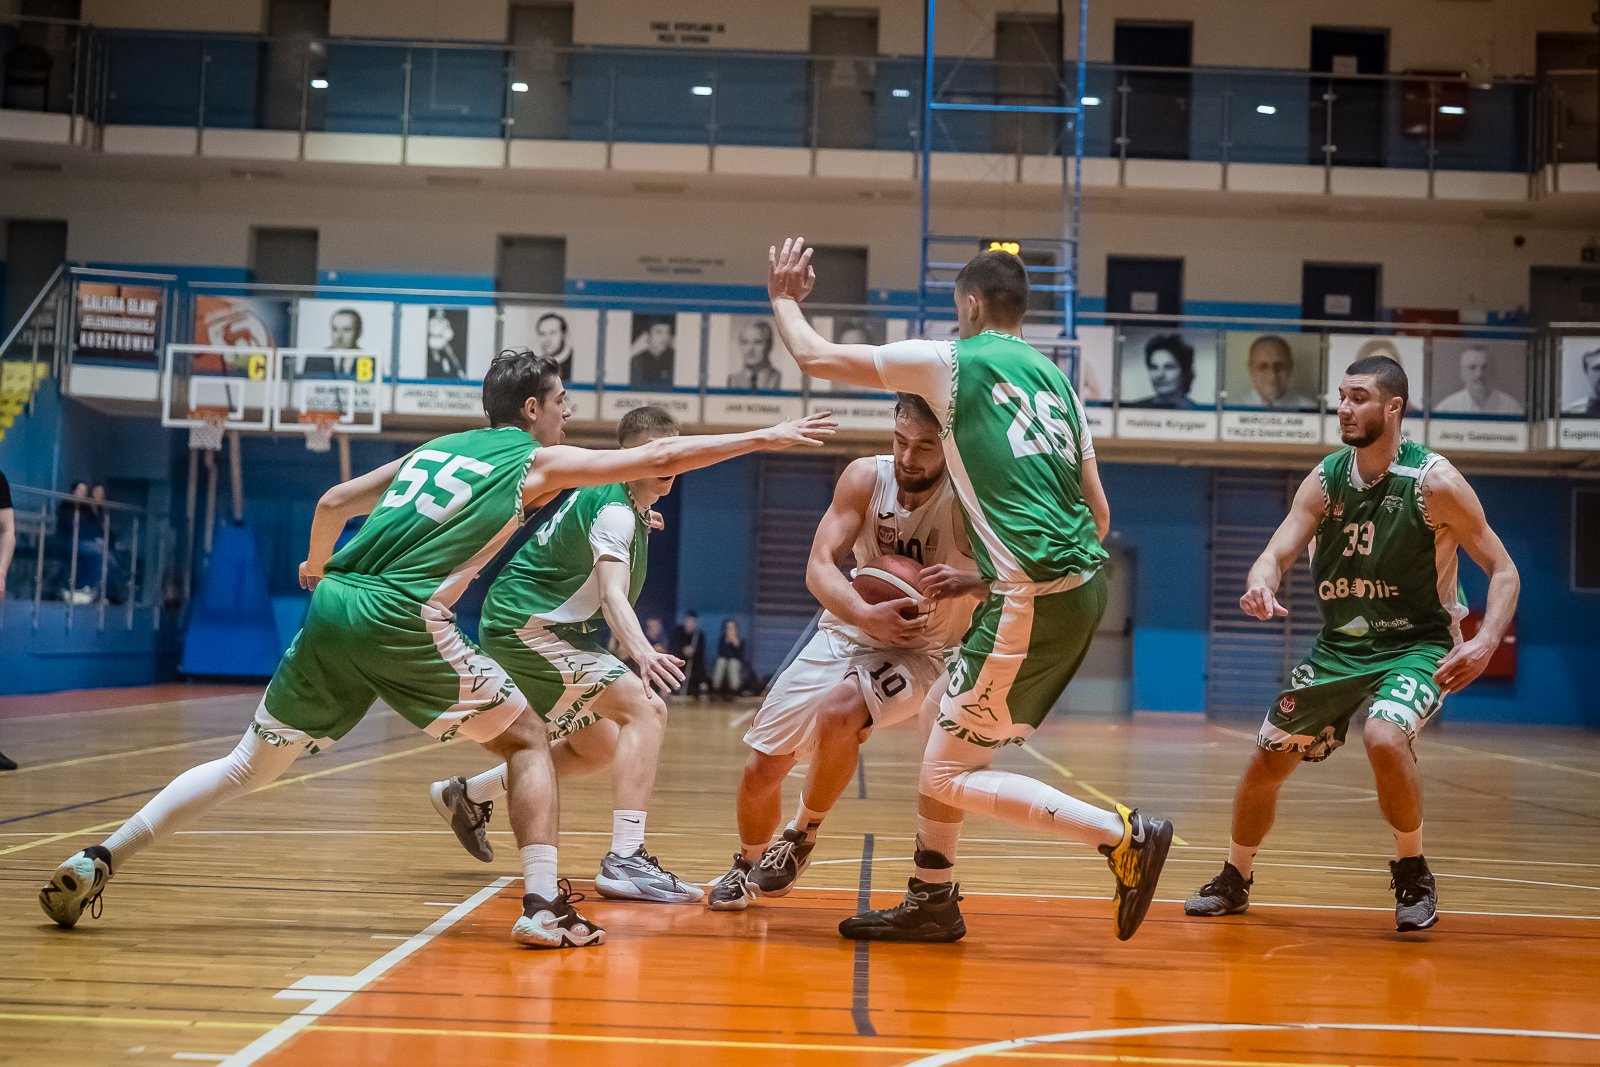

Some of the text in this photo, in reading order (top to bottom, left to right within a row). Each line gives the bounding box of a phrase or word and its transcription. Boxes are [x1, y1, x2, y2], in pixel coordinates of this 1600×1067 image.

[248, 354, 267, 380] C
[356, 356, 373, 381] B
[991, 382, 1077, 466] 26
[381, 449, 497, 524] 55
[1342, 520, 1376, 557] 33
[869, 660, 907, 698] 10
[1390, 673, 1435, 719] 33
